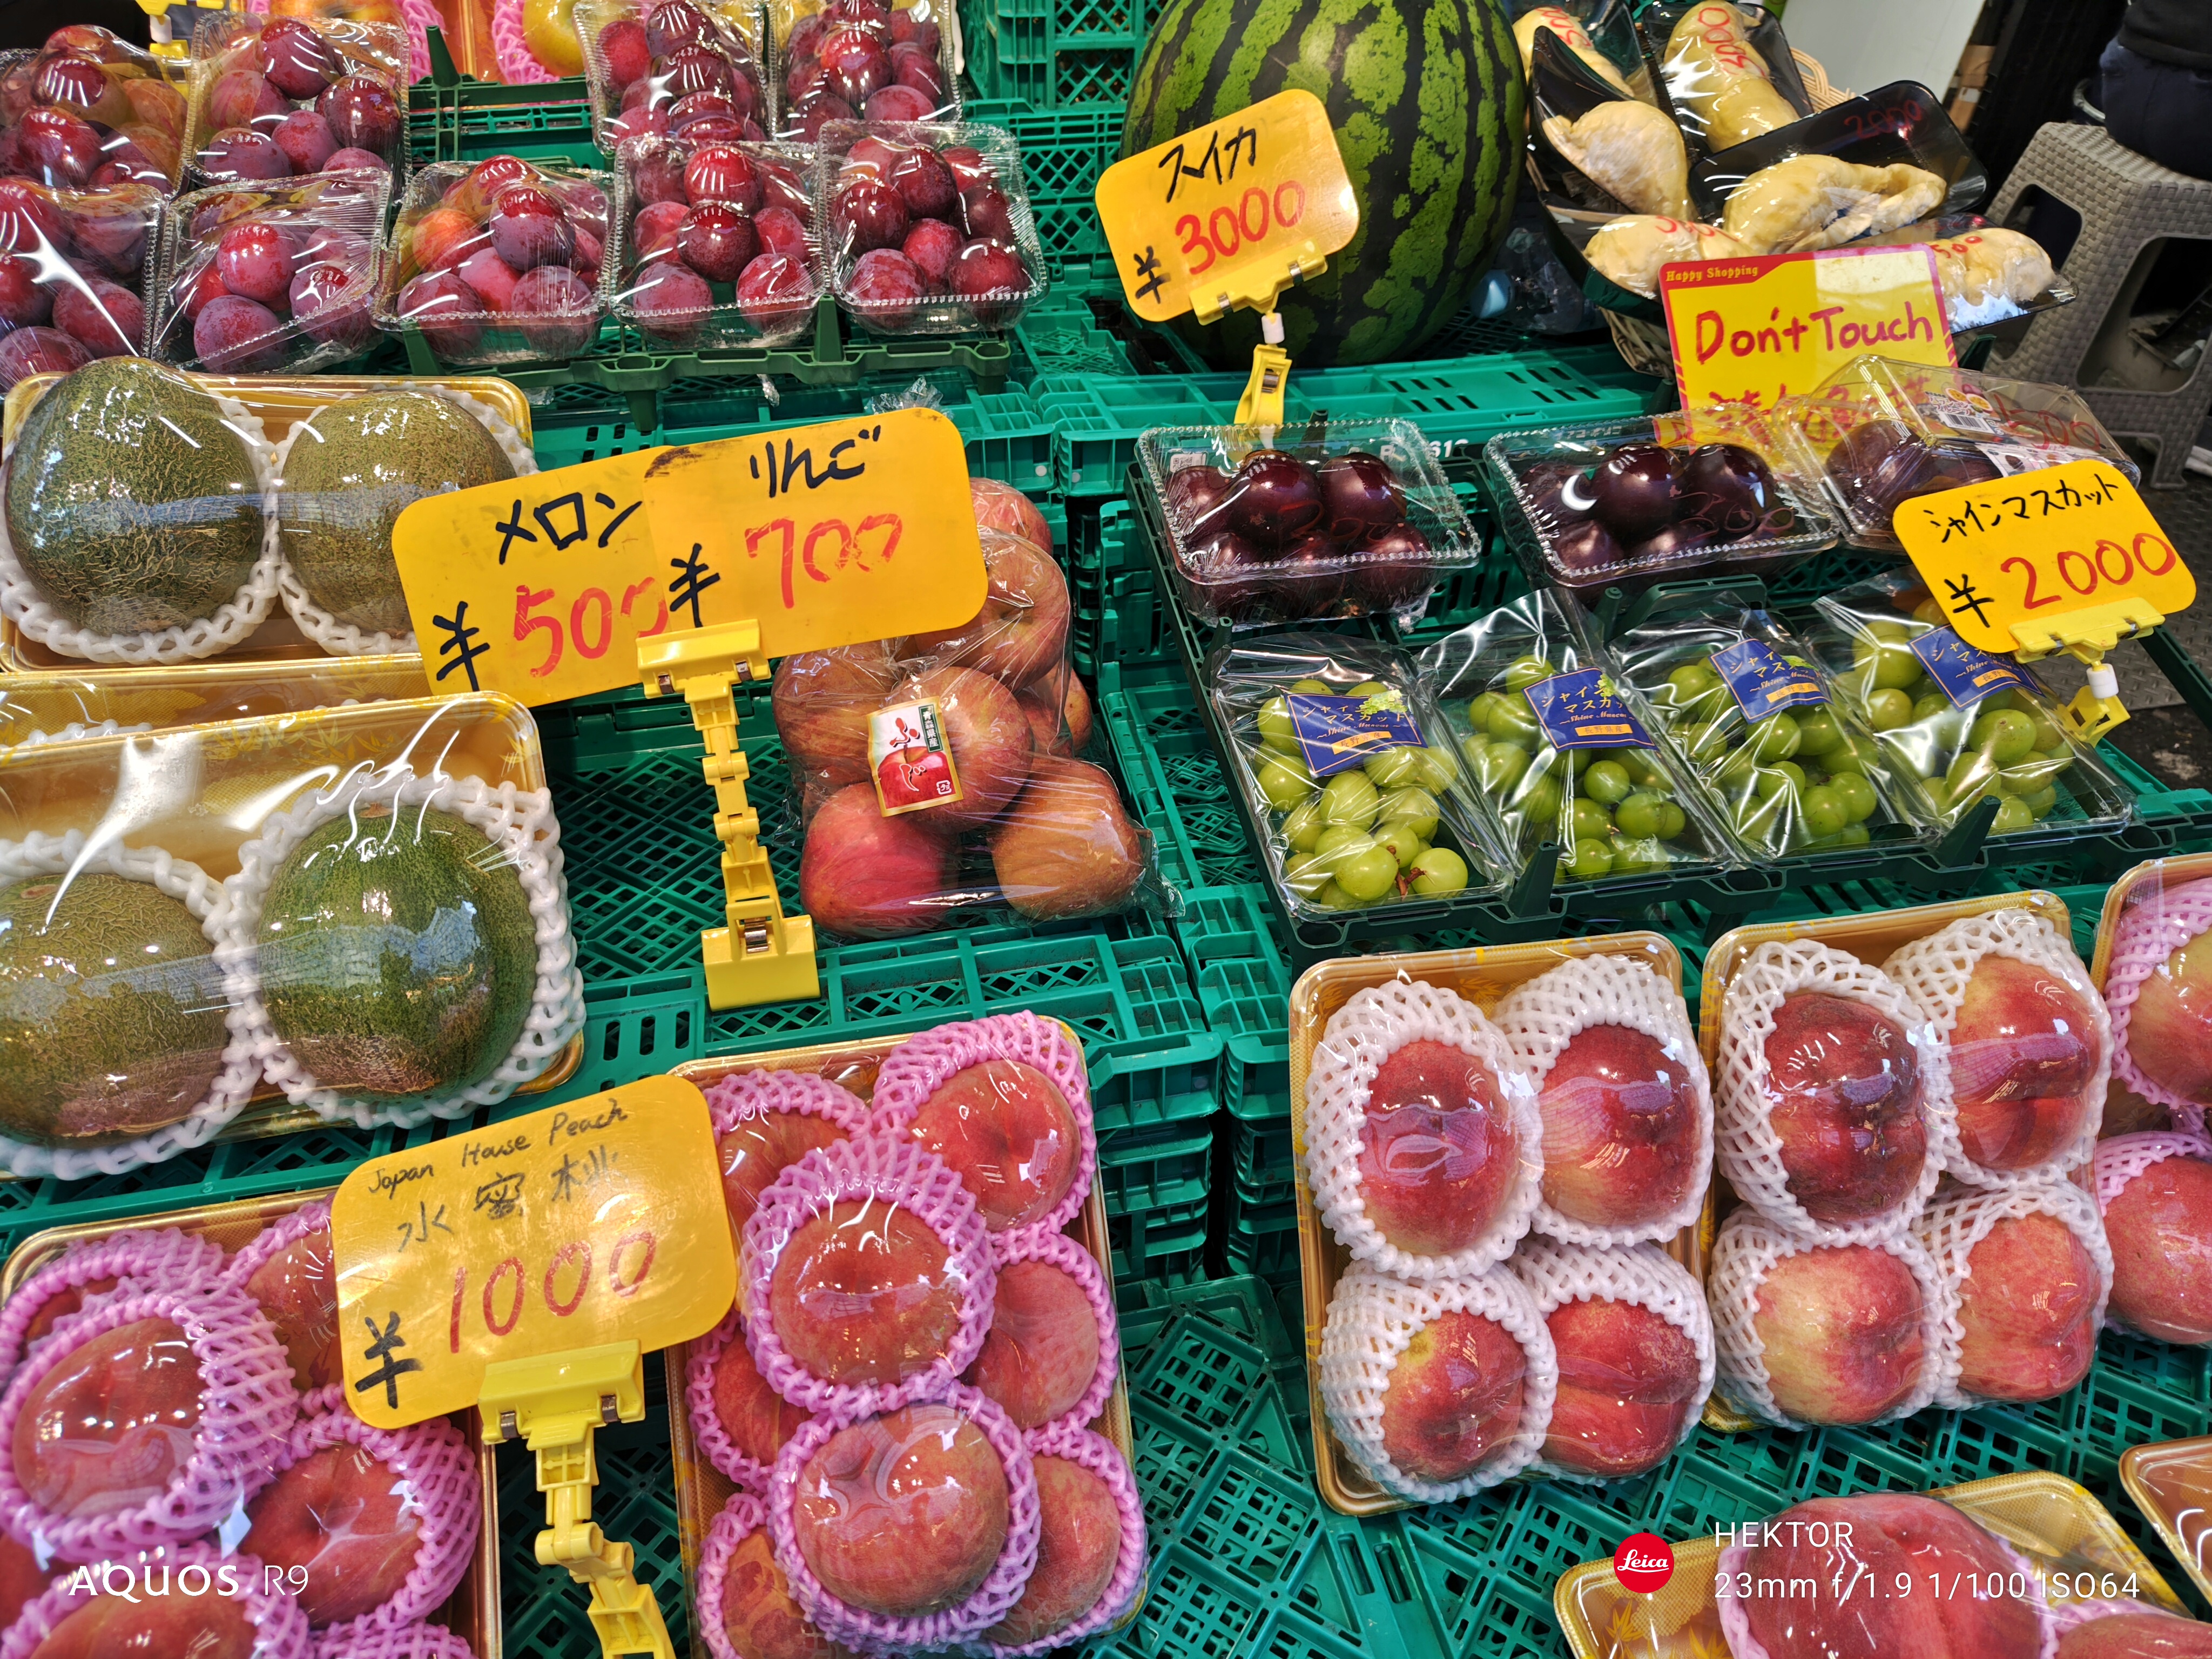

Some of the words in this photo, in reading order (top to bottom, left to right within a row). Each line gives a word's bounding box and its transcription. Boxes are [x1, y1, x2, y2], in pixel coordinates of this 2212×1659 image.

[1158, 126, 1256, 203] スイカ
[1175, 180, 1305, 275] 3000
[1666, 271, 1702, 282] Happy
[1707, 265, 1758, 278] Shopping
[1696, 307, 1808, 365] Don't
[1809, 301, 1933, 352] Touch
[750, 425, 881, 498] りんご
[496, 492, 643, 565] メロン
[1924, 474, 2119, 543] シャインマスカット
[669, 543, 720, 628] ¥
[745, 514, 902, 609] 700
[1944, 574, 1994, 628] ¥
[2000, 533, 2176, 610] 2000
[1730, 651, 1774, 674] シャイ
[922, 709, 939, 748] 青森県産
[1324, 709, 1405, 724] マスカット
[1564, 697, 1623, 713] マスカッ
[368, 1163, 434, 1200] Japan
[549, 1098, 629, 1146] Peach
[354, 1311, 424, 1408] ¥
[450, 1231, 656, 1353] 1000
